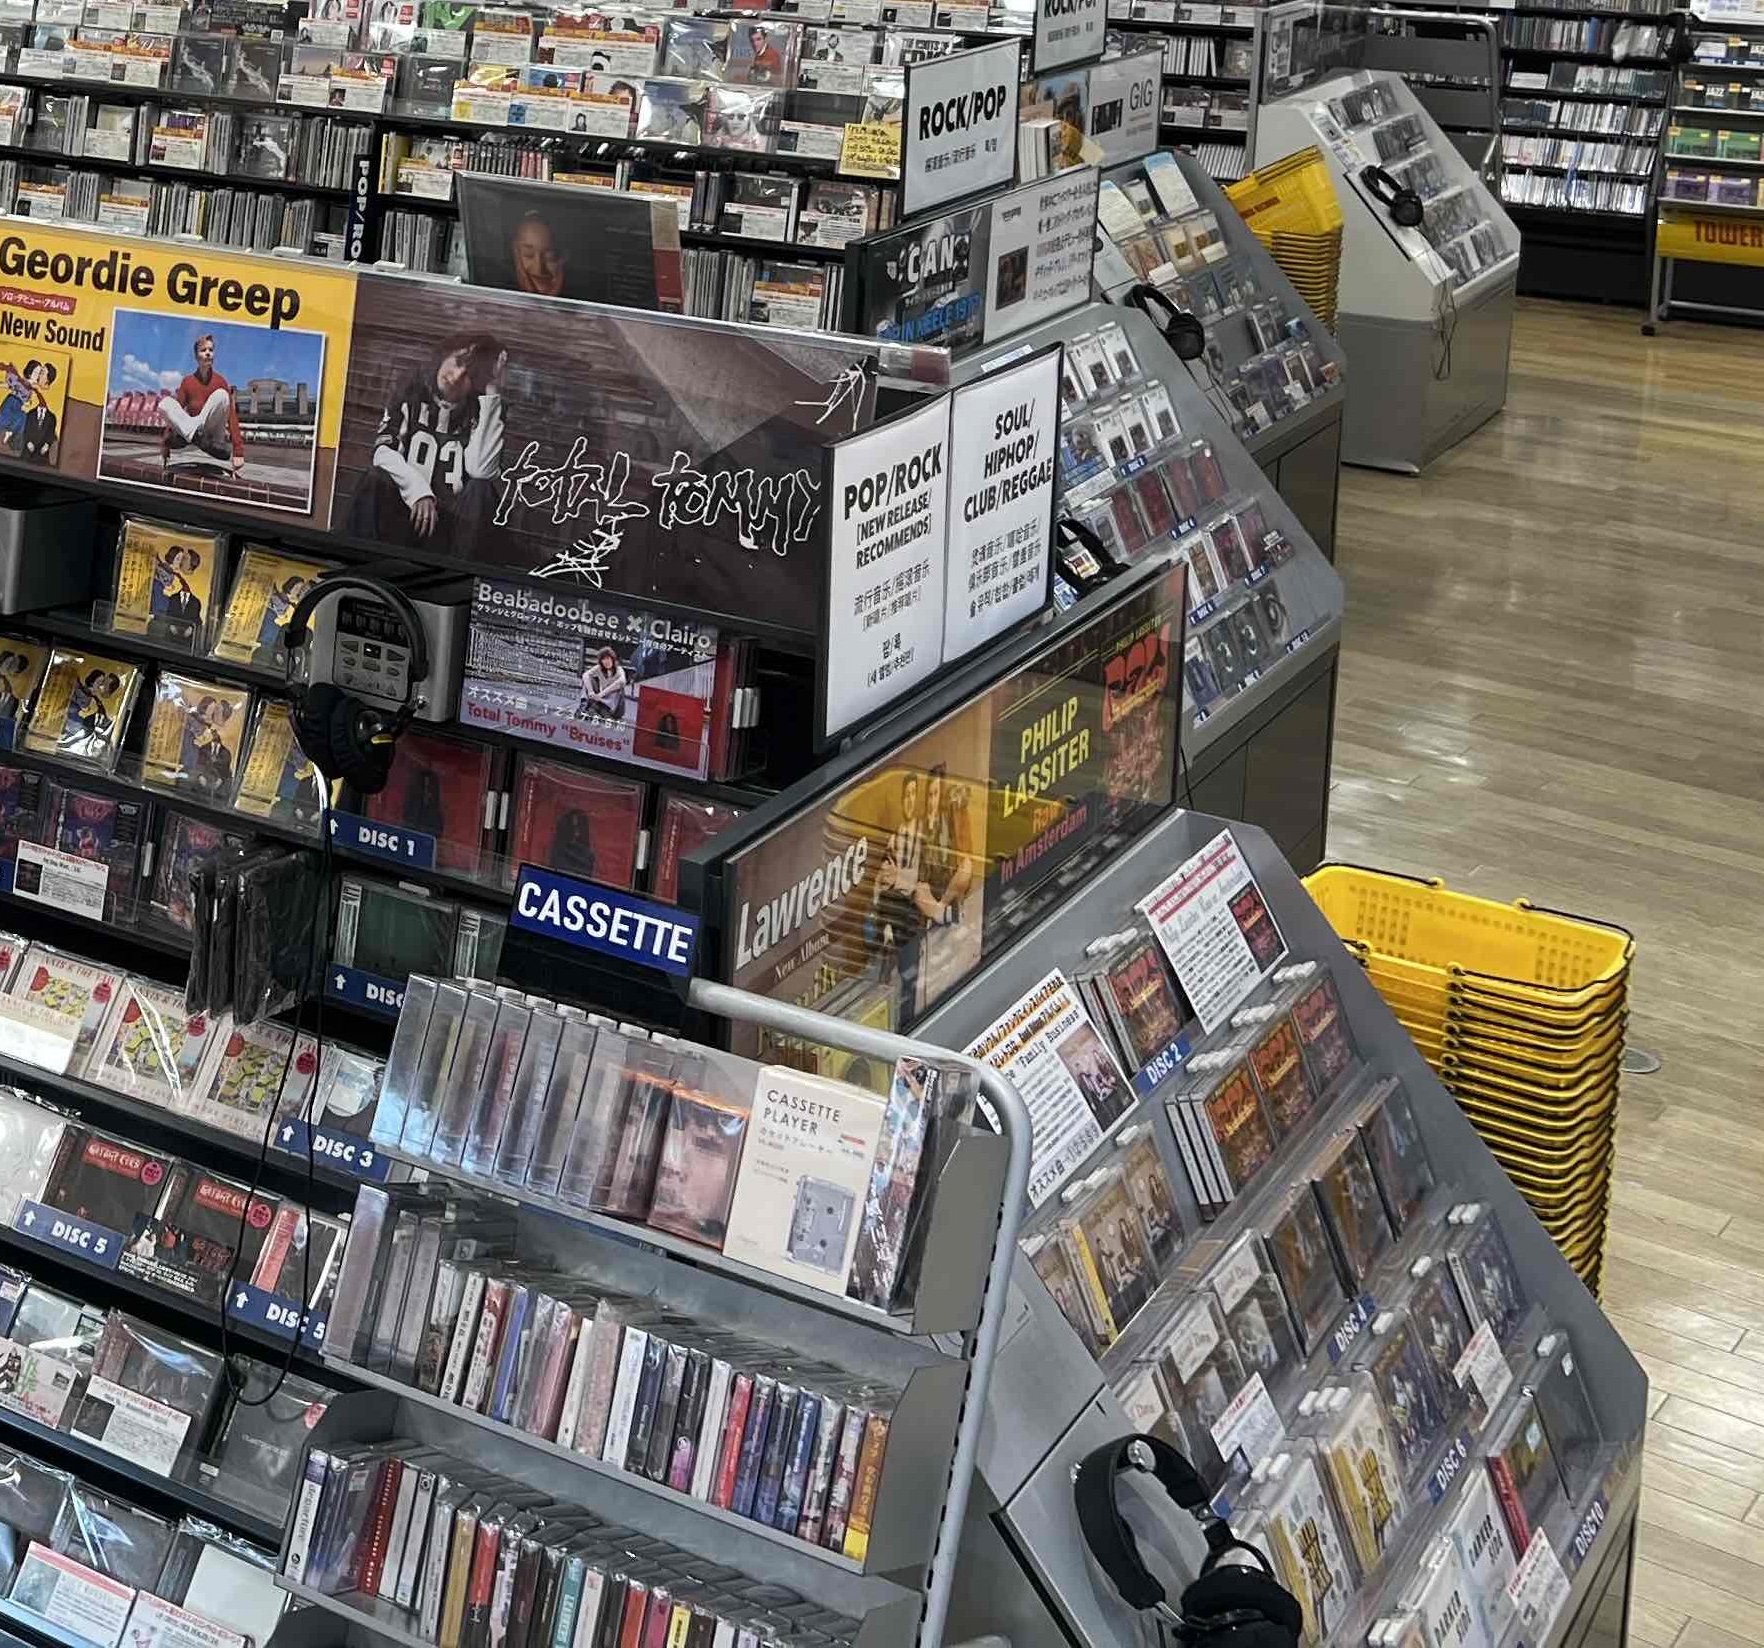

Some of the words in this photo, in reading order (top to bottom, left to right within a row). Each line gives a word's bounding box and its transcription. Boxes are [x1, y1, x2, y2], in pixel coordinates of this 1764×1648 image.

[919, 84, 1006, 141] ROCK/POP
[1129, 79, 1154, 111] GIG
[167, 263, 301, 330] Greep
[0, 310, 39, 340] New
[44, 318, 105, 352] Sound
[994, 399, 1037, 441] SOUL/
[984, 430, 1040, 480] HIPHOP/
[844, 442, 943, 521] POP/ROCK
[963, 456, 1054, 524] CLUB/REGGAE
[856, 511, 884, 547] [NEW
[886, 488, 933, 530] RELEASE/
[856, 512, 932, 570] RECOMMENDS]
[478, 583, 620, 630] Beabadoobee
[649, 619, 711, 649] Clairo
[467, 702, 501, 722] Total
[505, 710, 557, 737] Tommy
[1020, 696, 1078, 764] PHILIP
[1003, 728, 1090, 818] LASSITER
[357, 826, 399, 851] DISC
[406, 838, 415, 856] 1
[1014, 803, 1087, 871] Amsterdam
[517, 881, 694, 965] CASSETTE
[736, 836, 868, 972] Lawrence
[1147, 1056, 1174, 1086] DISC
[1170, 1043, 1184, 1063] 2
[763, 1106, 819, 1136] PLAYER
[766, 1089, 841, 1124] CASSETTE
[312, 1133, 352, 1161] DISC
[358, 1147, 373, 1169] 3
[51, 1219, 90, 1249] DISC
[93, 1236, 109, 1256] 5
[265, 1303, 310, 1334] DISC
[313, 1320, 326, 1340] 5
[1335, 1312, 1359, 1350] DISC
[1357, 1302, 1369, 1323] 4
[1436, 1450, 1459, 1491] DISC
[1457, 1442, 1467, 1461] 6
[1574, 1517, 1595, 1557] DISC
